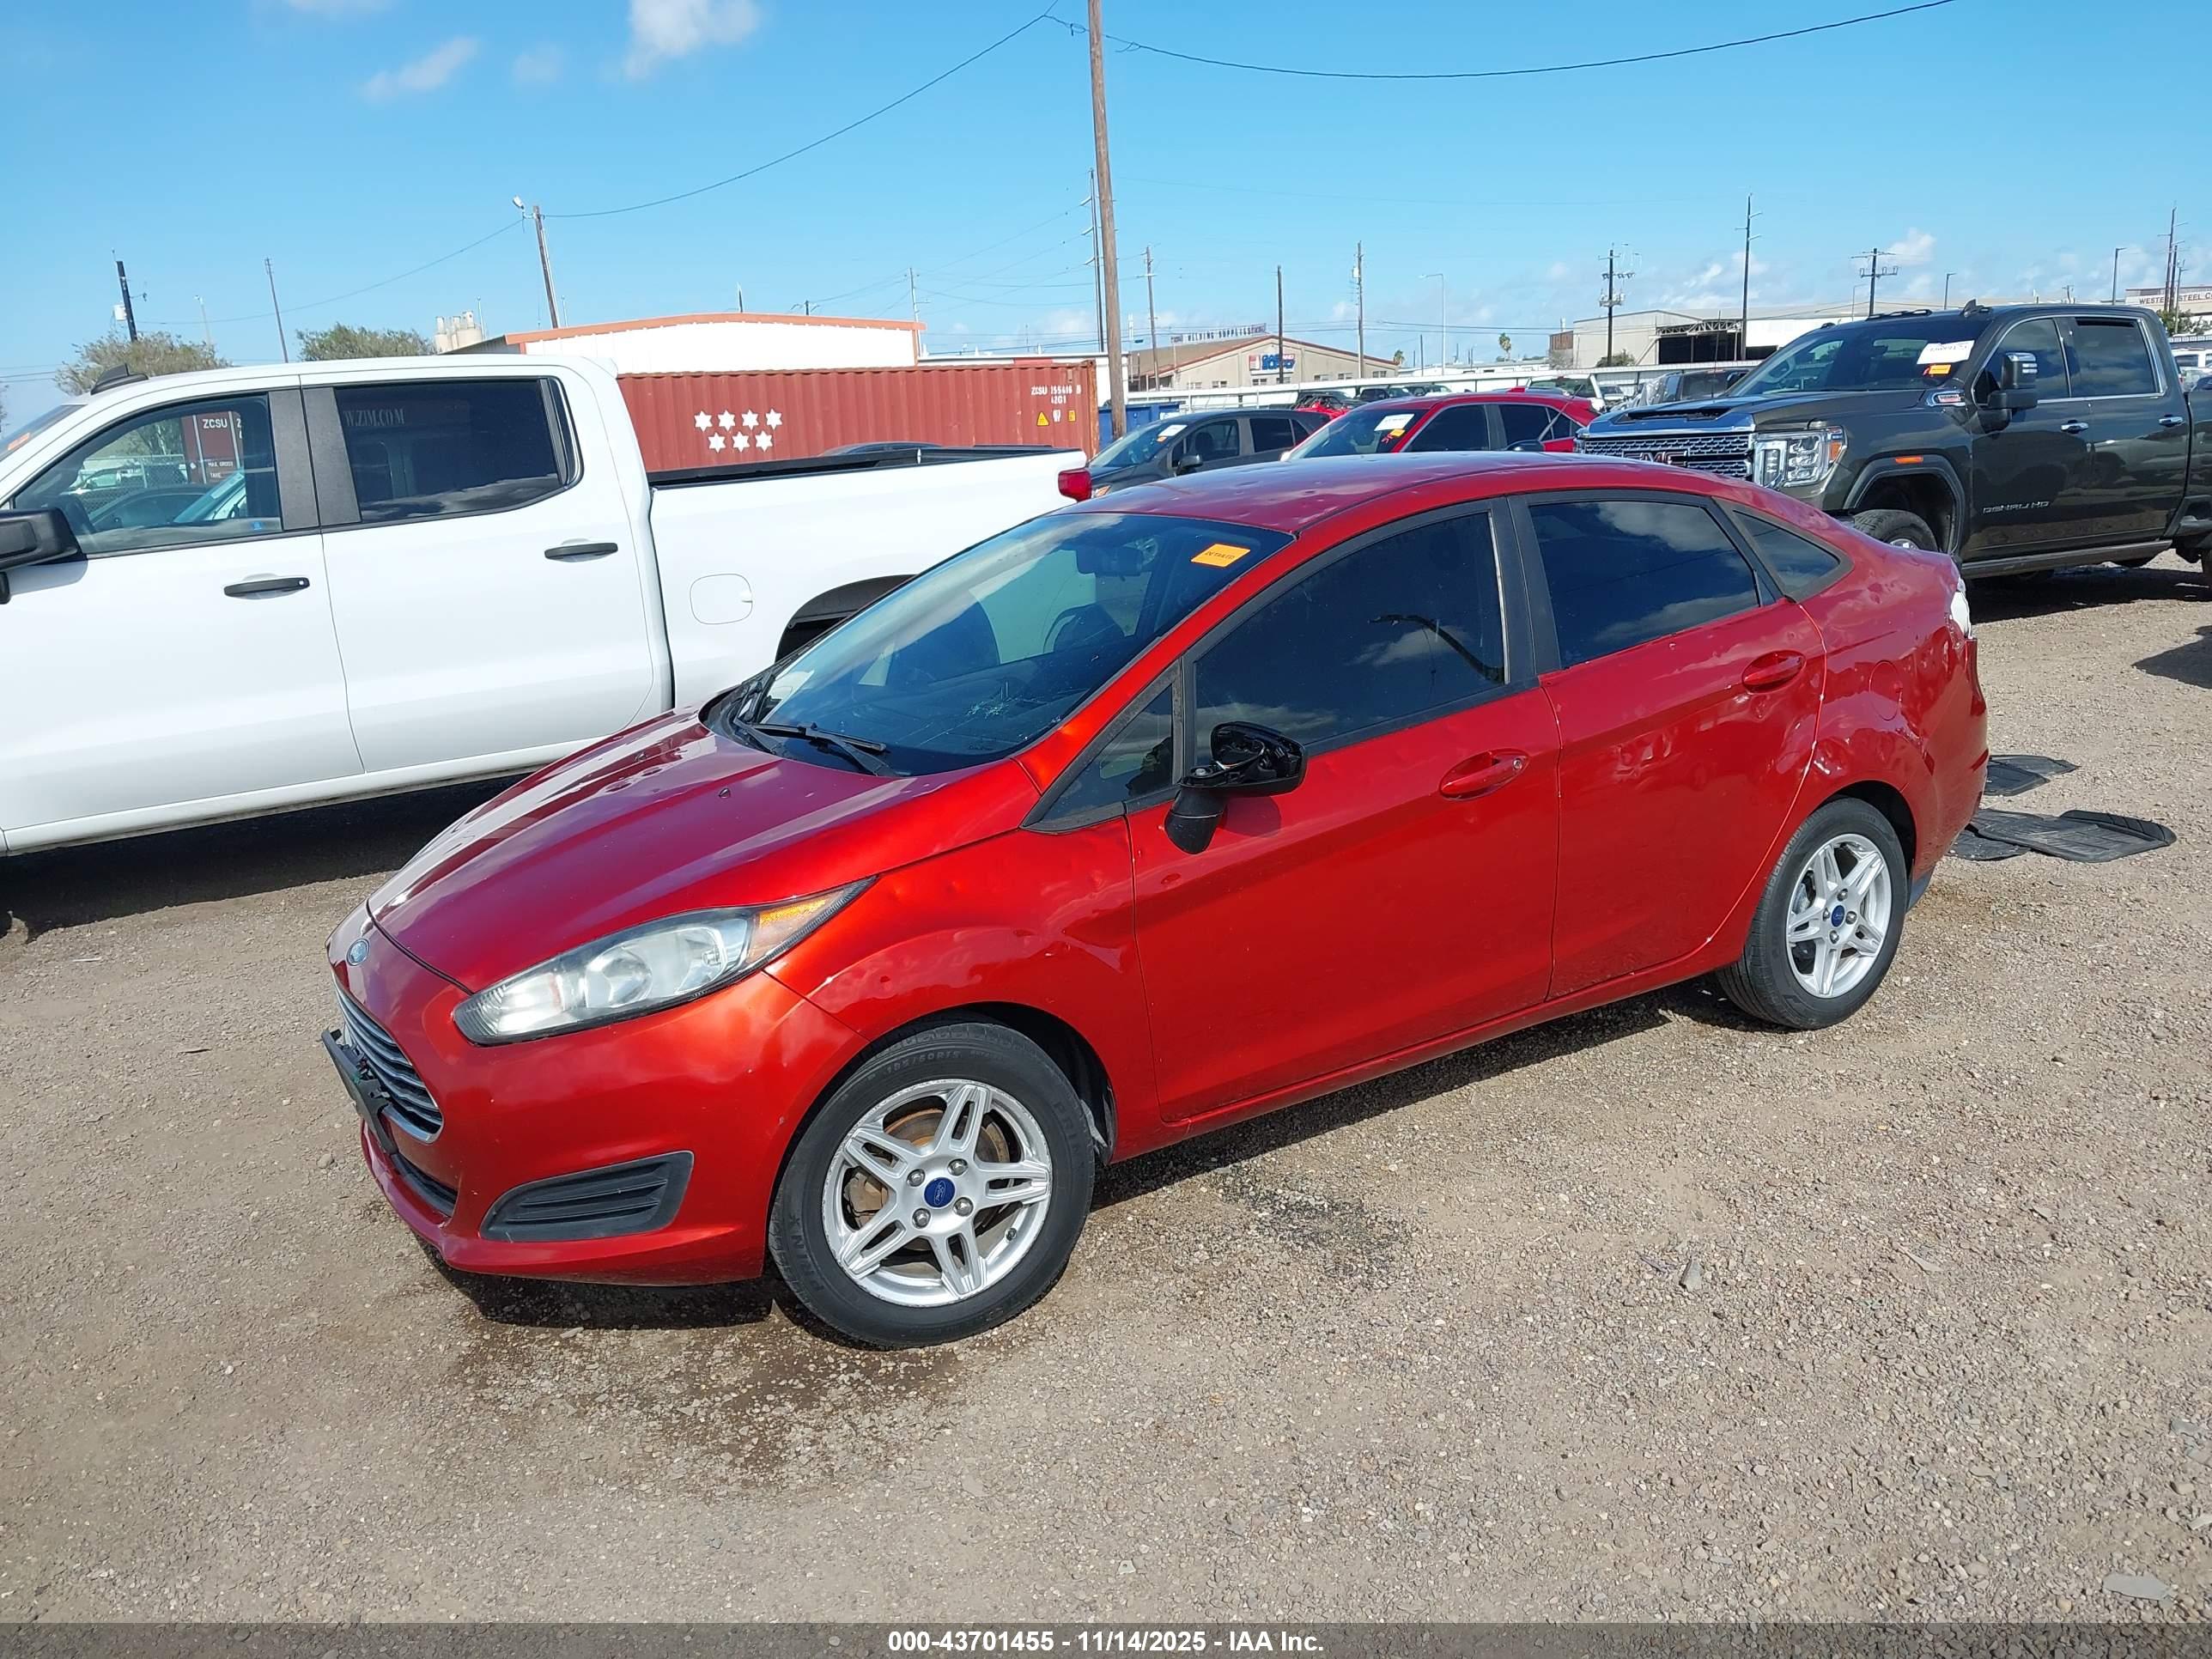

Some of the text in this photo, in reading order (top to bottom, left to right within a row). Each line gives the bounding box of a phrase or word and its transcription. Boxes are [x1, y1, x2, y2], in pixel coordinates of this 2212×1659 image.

[2139, 295, 2174, 304] WESTE
[1031, 385, 1048, 395] ZCSU
[203, 418, 228, 428] ZCSU
